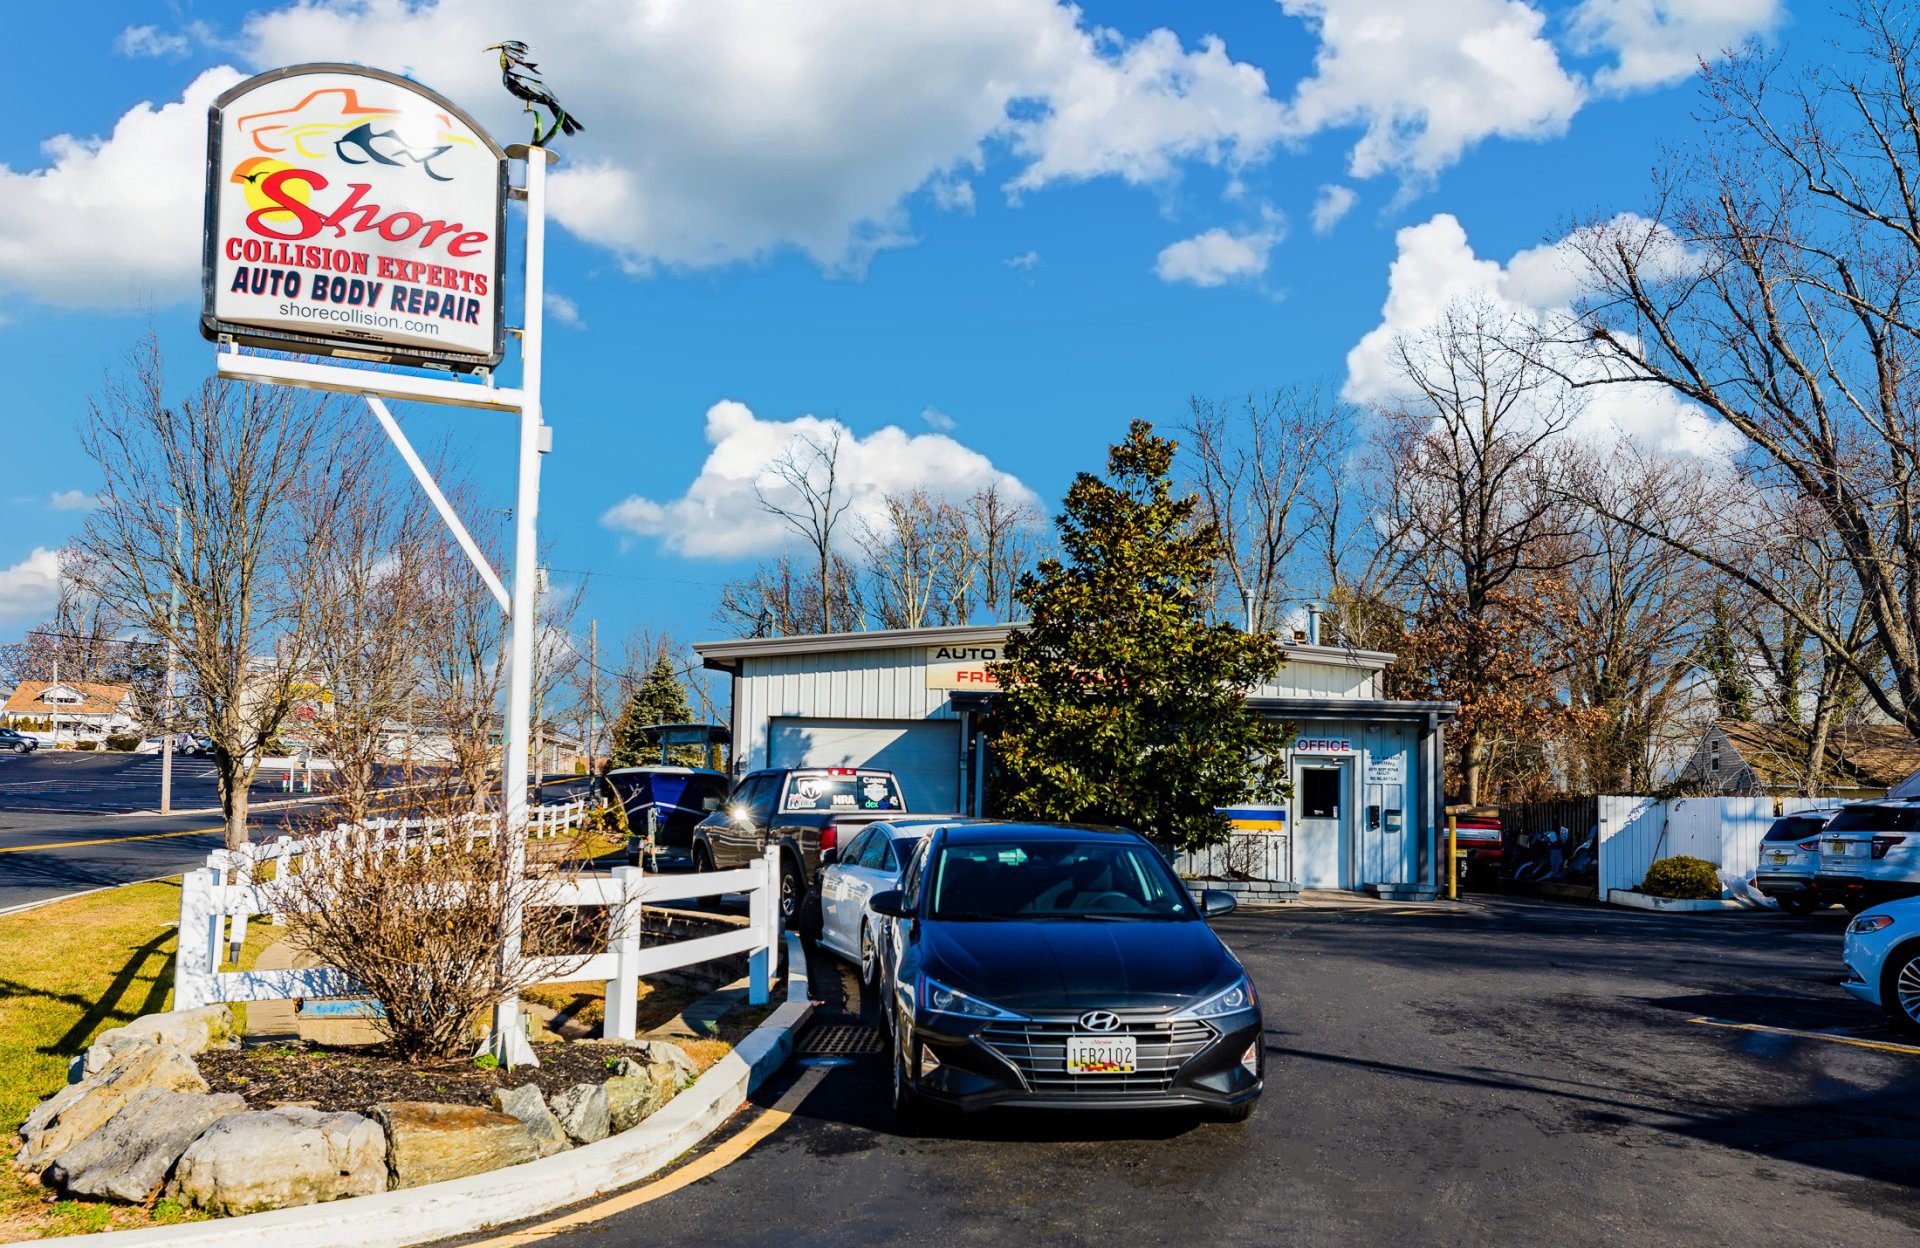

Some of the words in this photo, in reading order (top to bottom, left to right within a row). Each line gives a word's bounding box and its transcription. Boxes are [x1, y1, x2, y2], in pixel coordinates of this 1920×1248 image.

[246, 169, 488, 257] Shore
[225, 237, 369, 275] COLLISION
[376, 255, 488, 296] EXPERTS
[230, 266, 301, 299] AUTO
[311, 273, 384, 309] BODY
[390, 284, 481, 326] REPAIR
[279, 301, 439, 335] shorecollision.com
[936, 648, 996, 660] AUTO
[1297, 739, 1350, 752] OFFICE
[833, 794, 855, 805] NRA
[1073, 1046, 1132, 1067] 1EB2102
